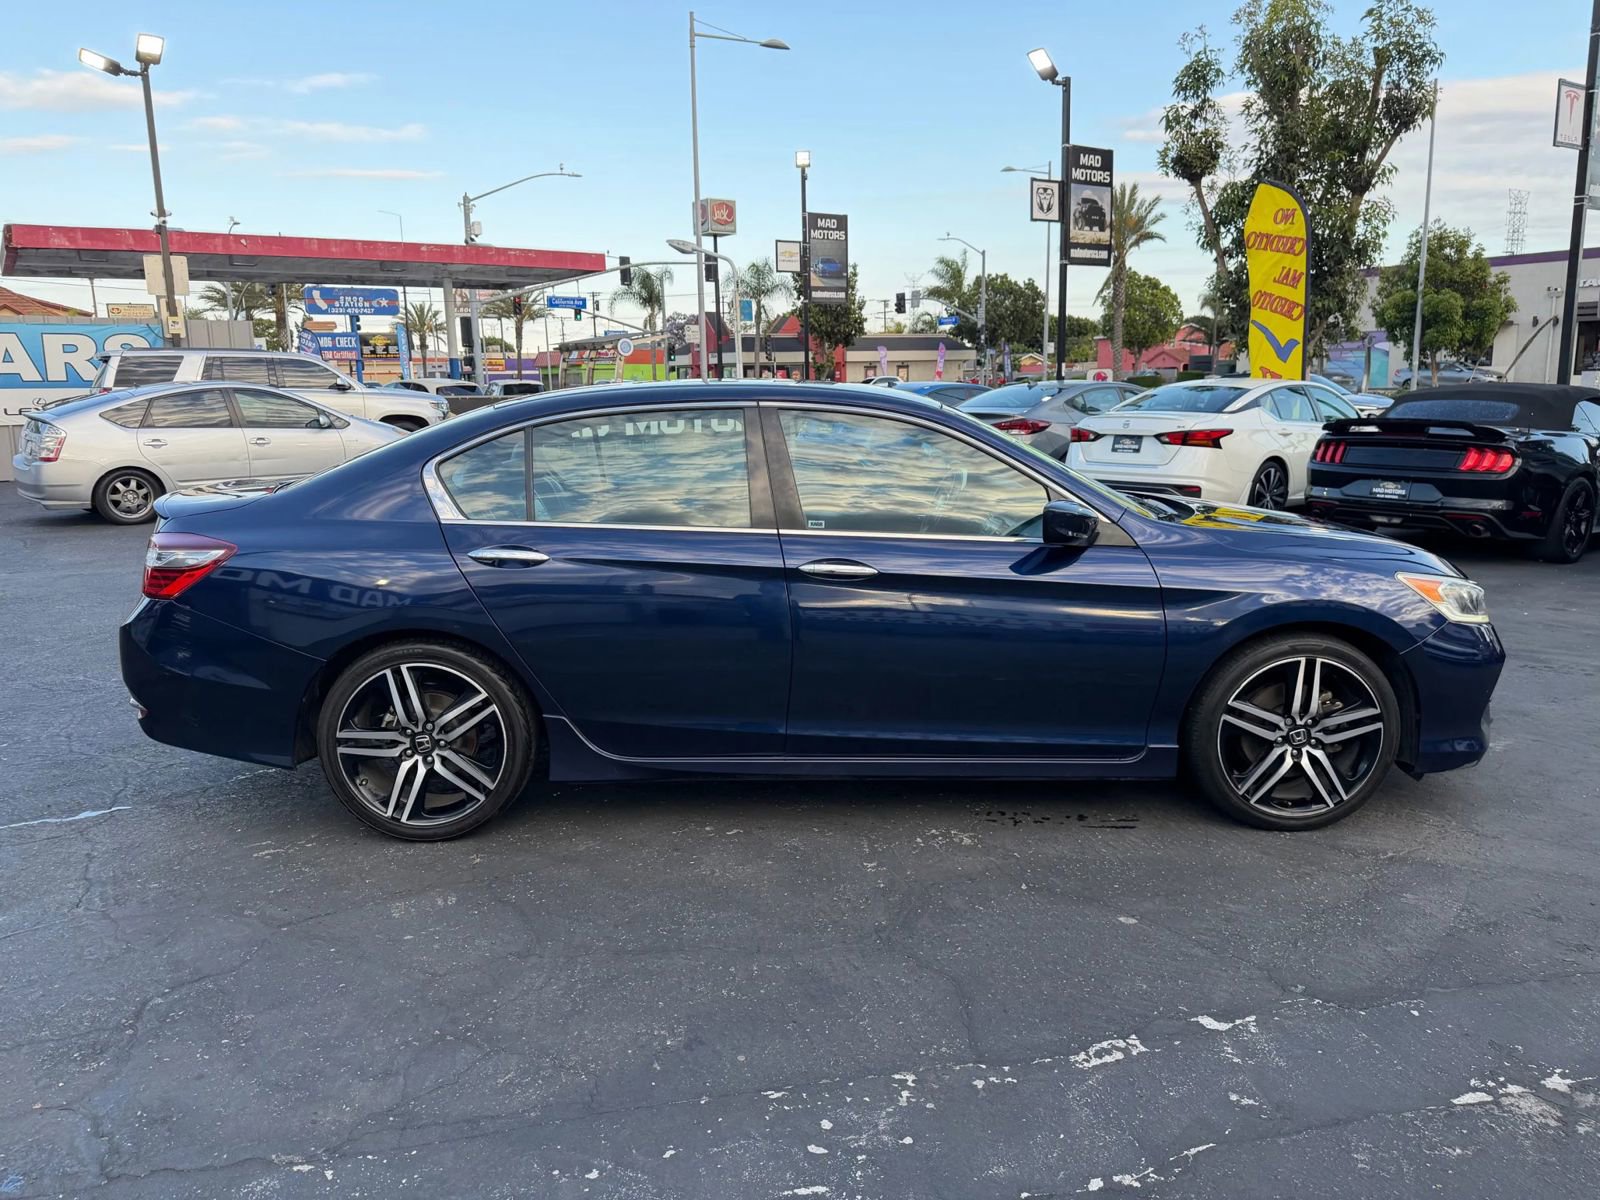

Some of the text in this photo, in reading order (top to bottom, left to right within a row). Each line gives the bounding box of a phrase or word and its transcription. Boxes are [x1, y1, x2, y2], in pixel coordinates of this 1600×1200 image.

[1080, 153, 1102, 167] MAD
[1072, 168, 1110, 183] MOTORS
[713, 204, 733, 221] Jack
[817, 218, 837, 228] MAD
[811, 229, 846, 240] MOTORS
[318, 336, 332, 348] MOG
[335, 336, 357, 348] CHECK
